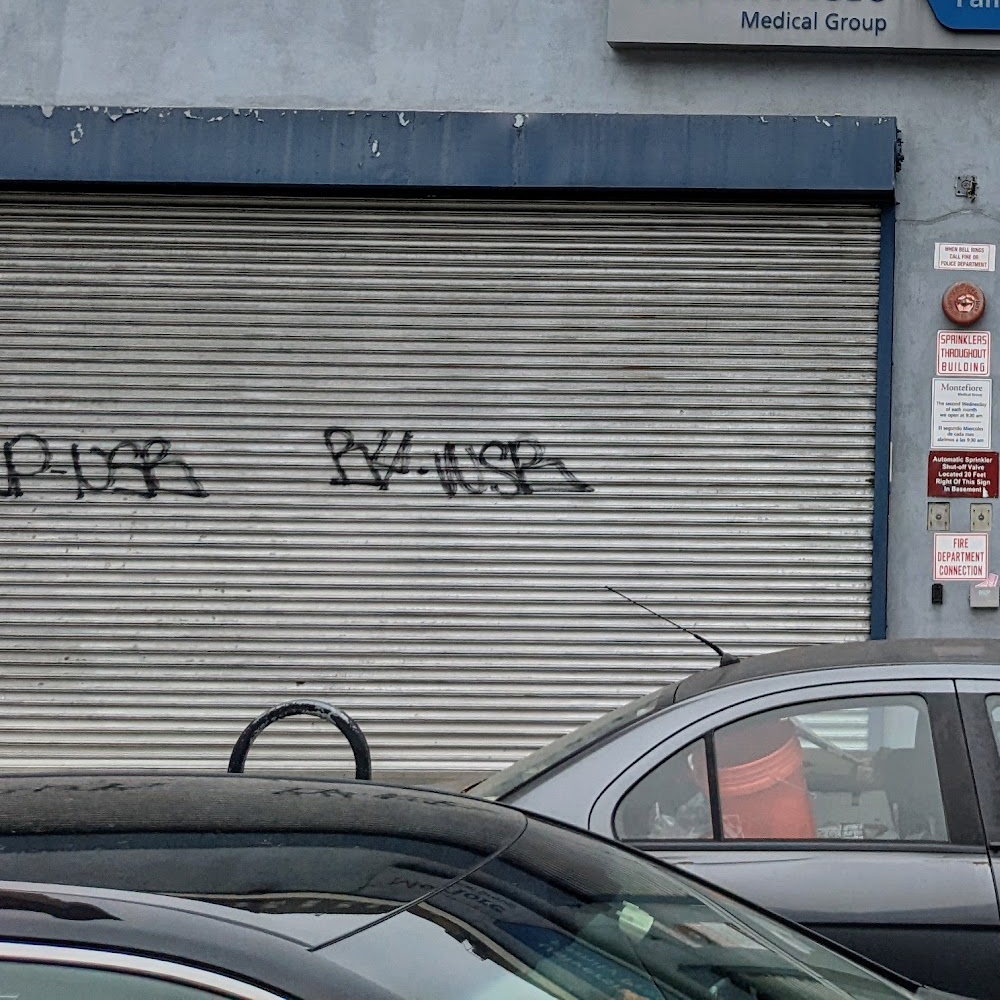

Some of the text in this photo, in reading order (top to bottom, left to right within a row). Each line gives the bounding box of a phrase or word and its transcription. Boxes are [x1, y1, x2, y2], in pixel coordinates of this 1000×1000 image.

[741, 10, 887, 36] Medical Group
[940, 334, 987, 345] SPRINKLERS
[940, 348, 987, 358] THROUGHOUT
[941, 361, 986, 372] BUILDING
[940, 383, 983, 392] Montefiore
[932, 455, 993, 464] Automatic Sprinkler
[942, 463, 967, 471] Shut-off
[935, 478, 952, 486] Right
[976, 479, 991, 487] Sign
[953, 538, 969, 549] FIRE
[937, 551, 985, 562] DEPARTMENT
[939, 565, 983, 576] CONNECTION
